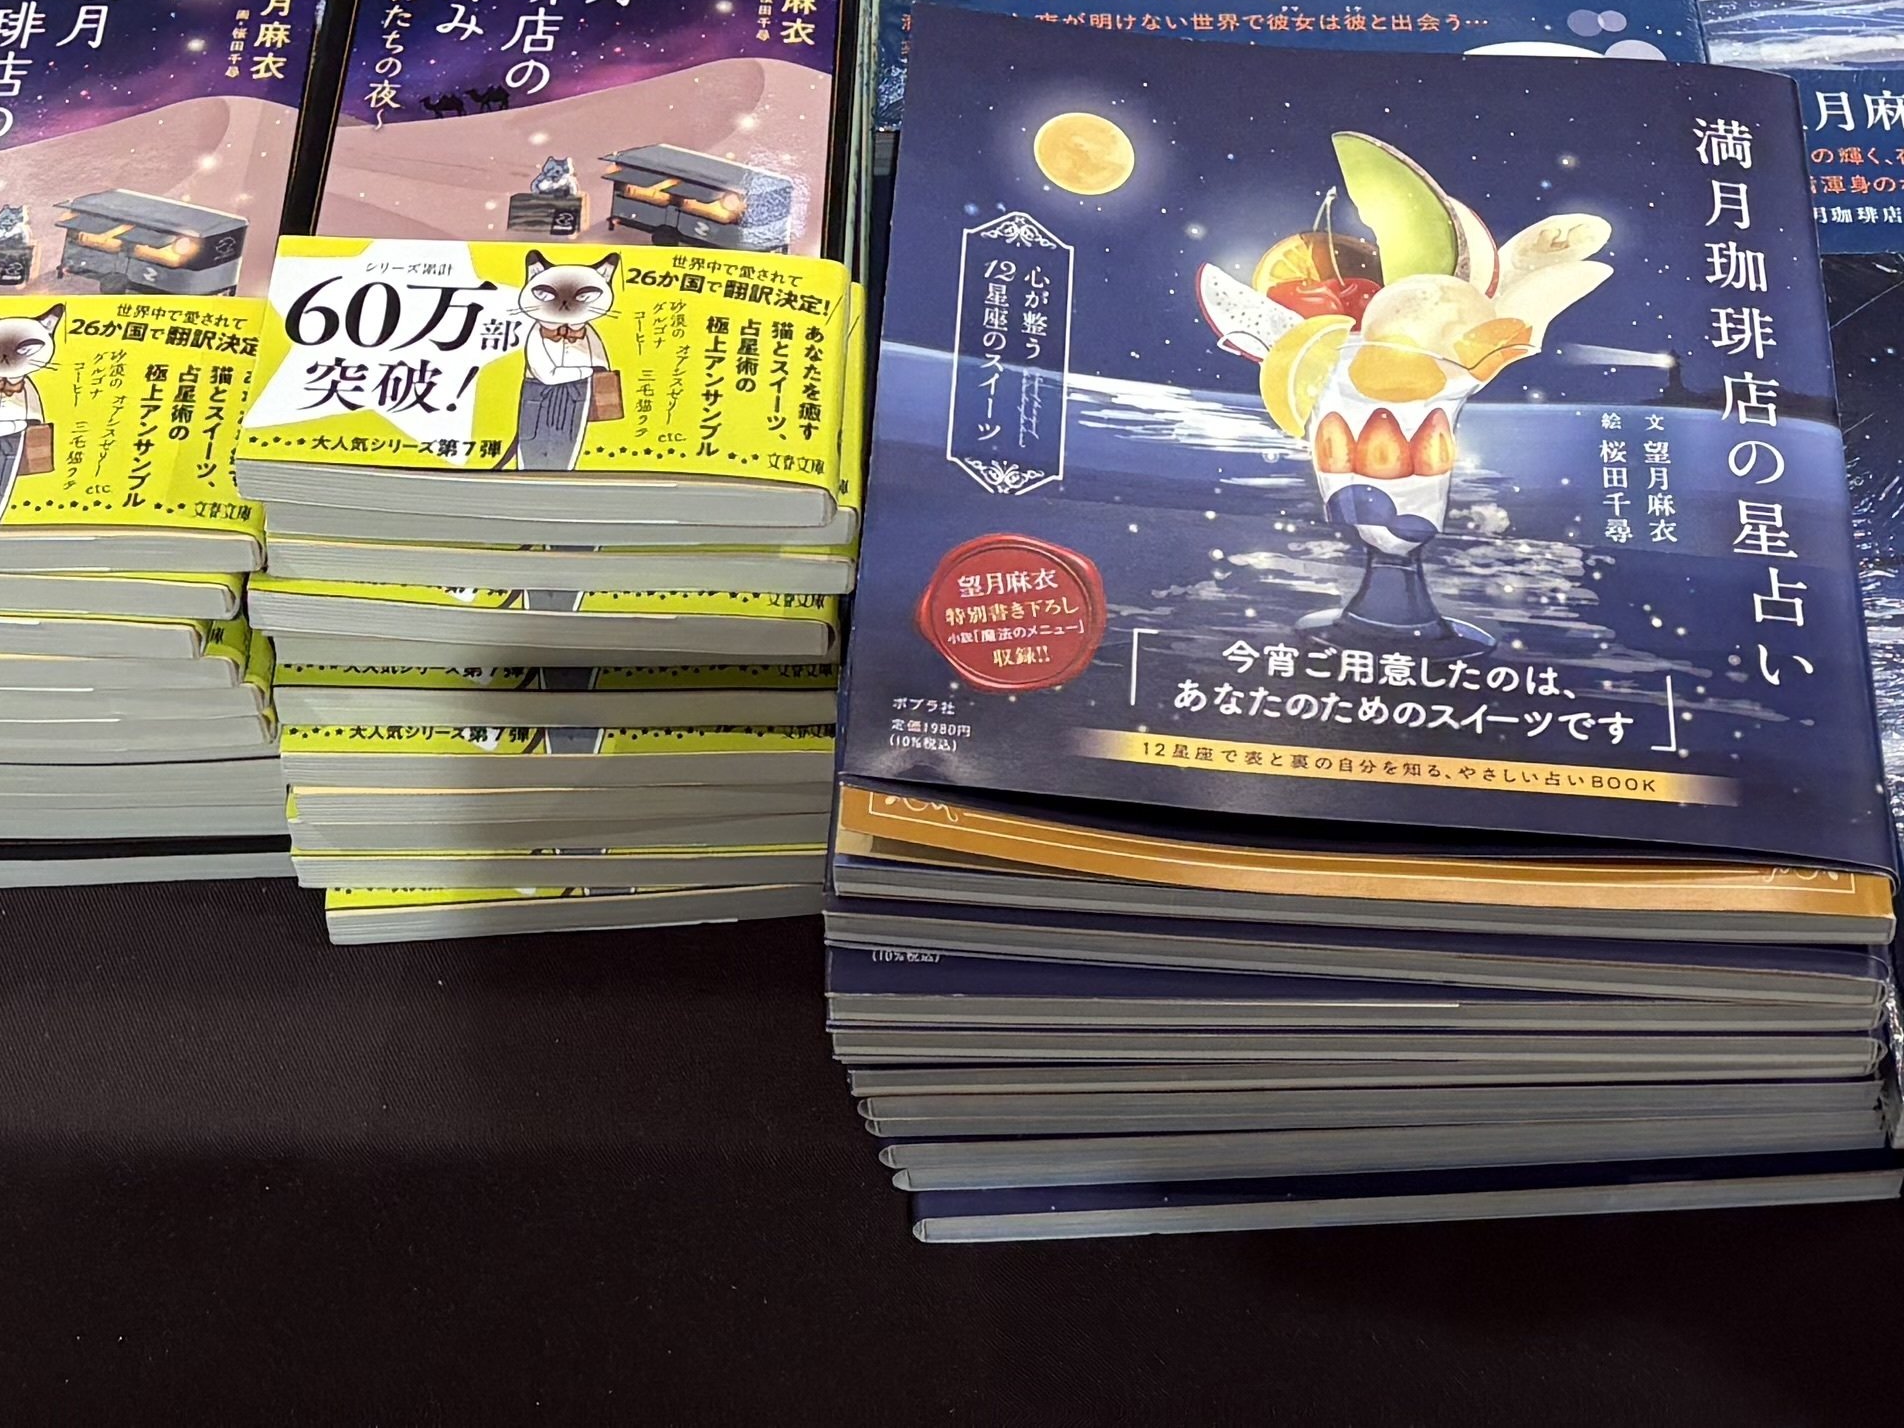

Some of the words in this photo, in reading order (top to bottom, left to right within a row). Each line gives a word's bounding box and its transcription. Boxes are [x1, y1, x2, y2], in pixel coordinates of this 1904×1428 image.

[283, 275, 524, 354] 60万部
[977, 259, 1017, 441] 12星座のスイーツ
[1021, 266, 1050, 360] 心が整う
[296, 356, 480, 415] 突破!
[696, 315, 733, 459] 極上アンサンブル
[736, 320, 764, 395] 占星術の
[798, 326, 827, 442] あなたを癒す
[1693, 118, 1815, 687] 満月珈琲店の星占い
[311, 436, 502, 460] 大人気シリーズ第7弾
[1600, 439, 1633, 544] 桜田千尋
[1644, 441, 1679, 544] 望月麻衣
[945, 596, 1080, 630] 特別書き下ろし
[957, 570, 1060, 599] 望月麻衣
[992, 644, 1052, 667] 収録!!
[892, 697, 957, 716] ポプラ社
[892, 718, 972, 738] 定価1980円
[1142, 741, 1658, 795] 12星座で表と裏の自分を知る、やさしい占いBOOK
